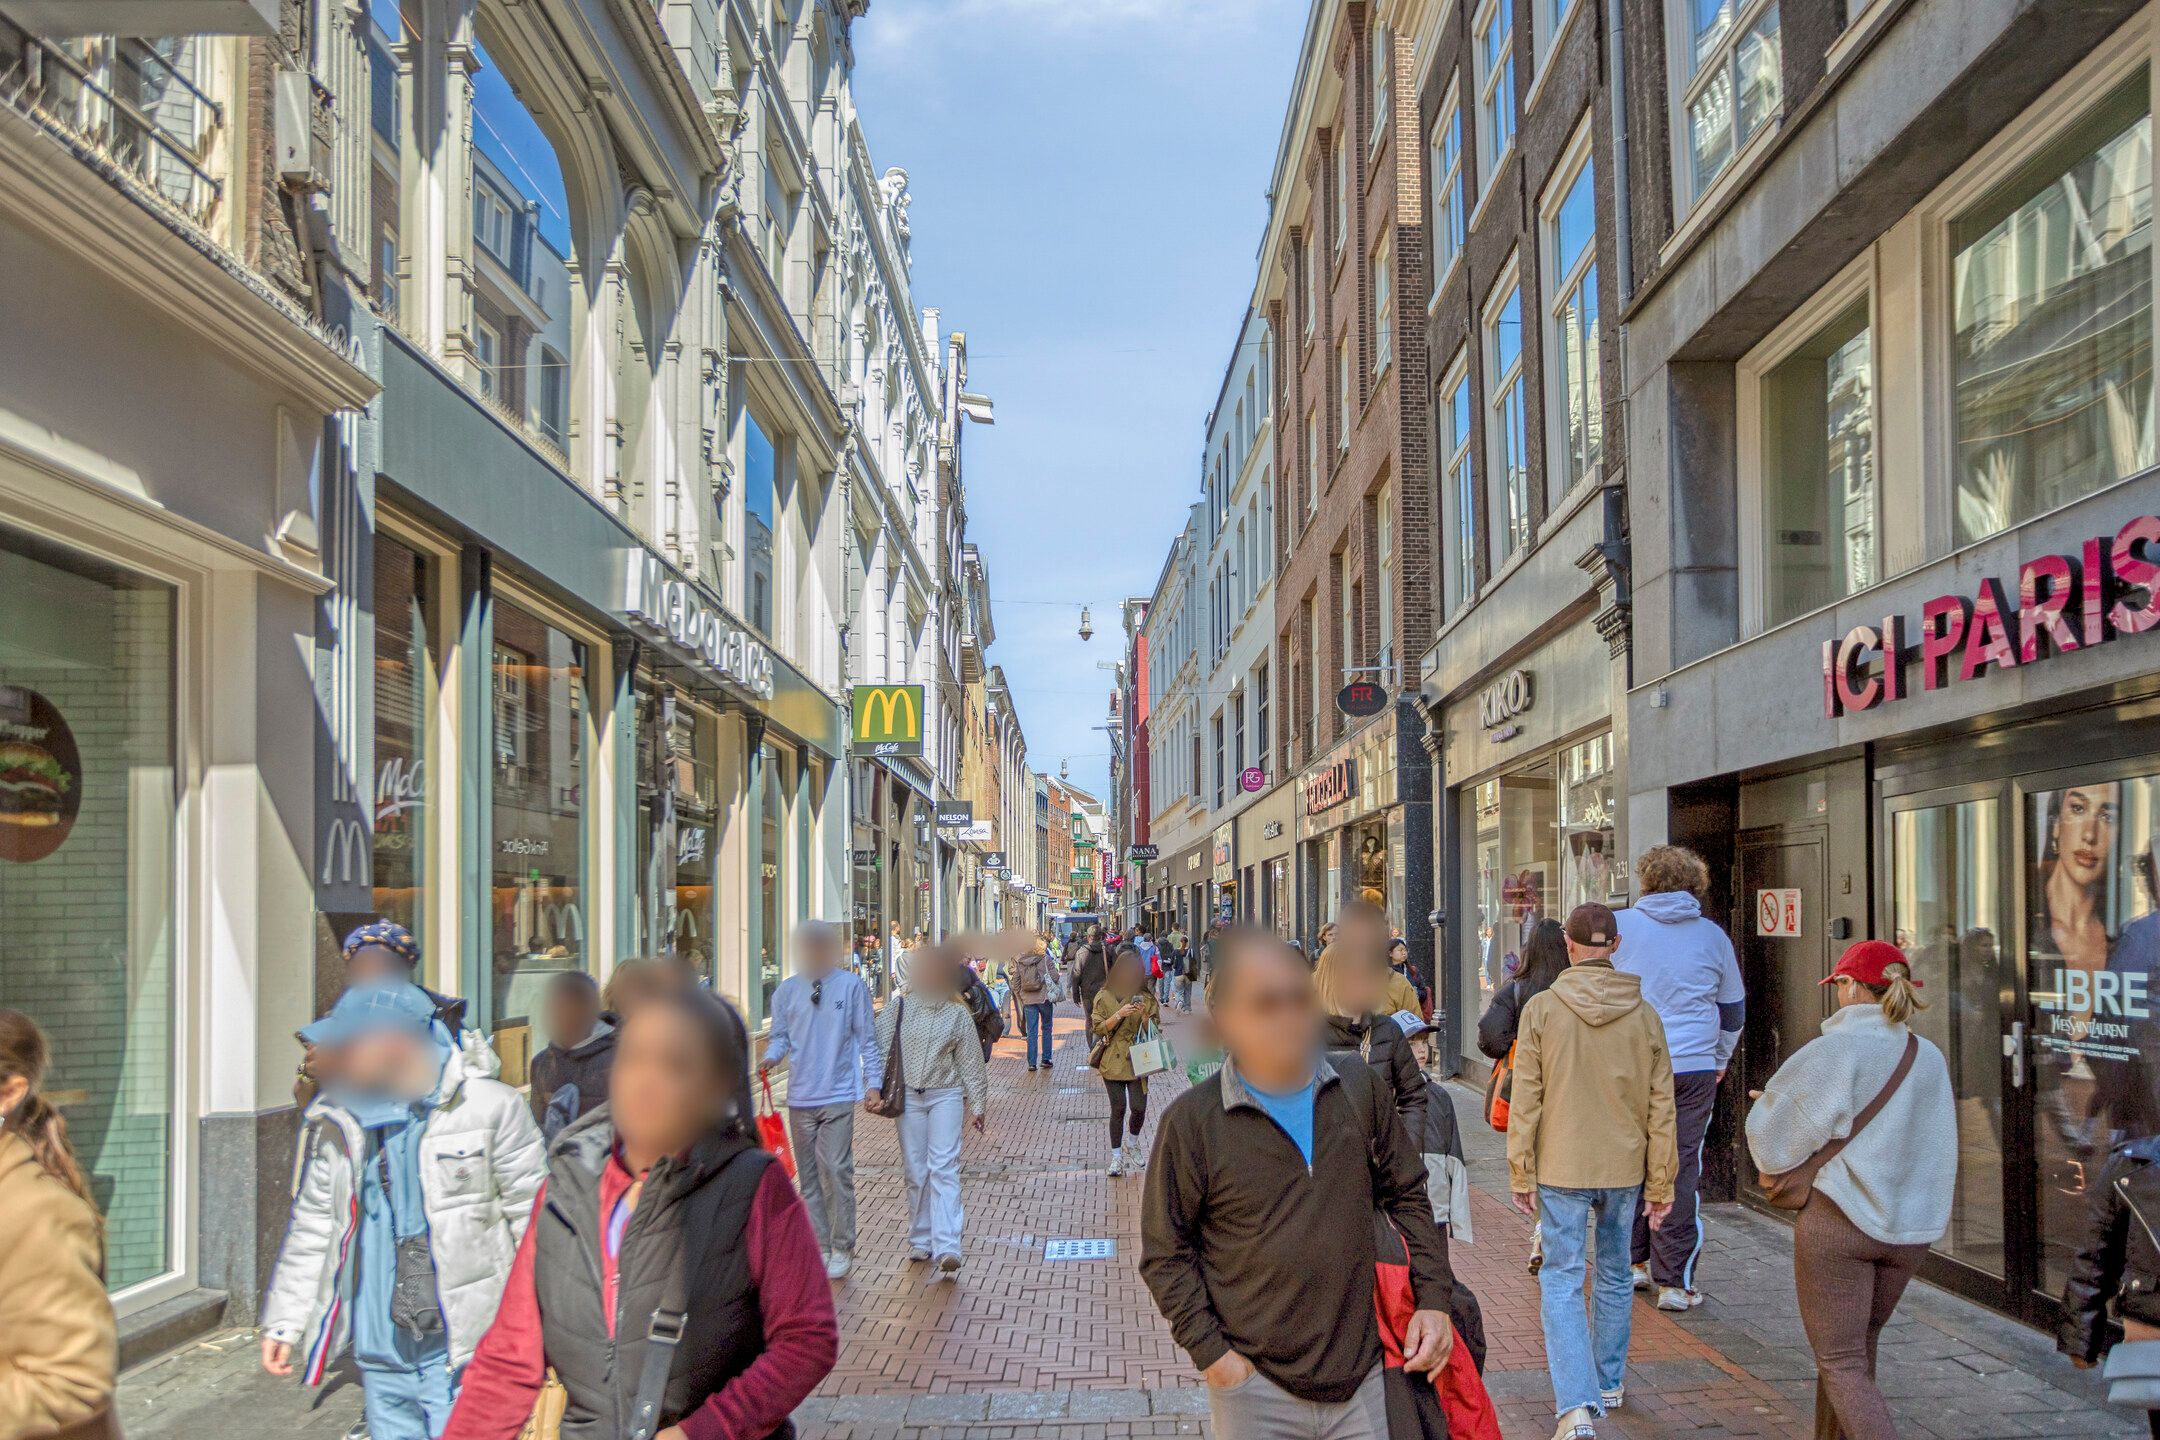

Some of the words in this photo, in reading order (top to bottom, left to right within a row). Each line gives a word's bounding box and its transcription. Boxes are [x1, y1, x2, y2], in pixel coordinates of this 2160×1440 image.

[1822, 615, 1906, 719] ICI
[1923, 515, 2160, 691] PARIS
[1480, 670, 1530, 730] KIKO
[1616, 860, 1629, 880] 231
